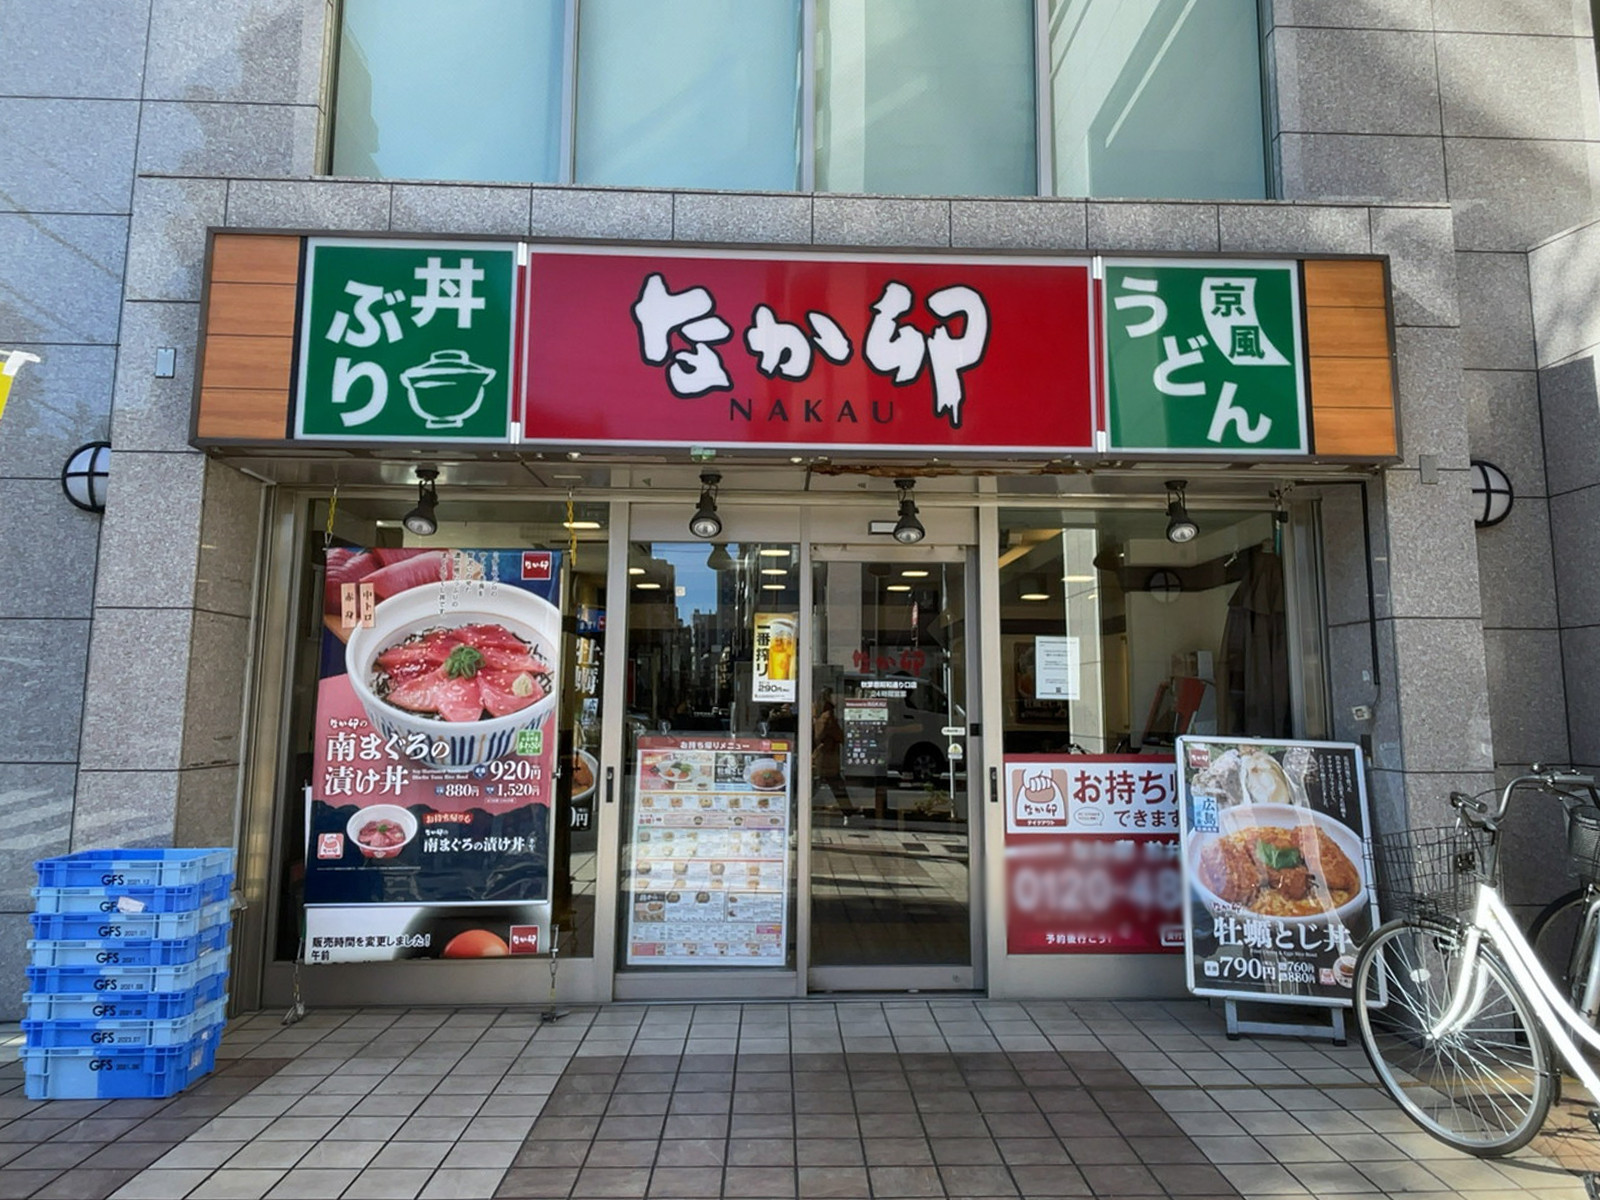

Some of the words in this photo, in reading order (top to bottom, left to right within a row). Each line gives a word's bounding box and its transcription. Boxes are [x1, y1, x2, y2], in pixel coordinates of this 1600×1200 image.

[1209, 281, 1265, 360] 京風
[631, 271, 990, 429] なか卯
[1113, 276, 1272, 444] うどん
[730, 397, 895, 424] NAKAU
[524, 560, 549, 571] なか卯
[344, 591, 354, 620] 赤身
[362, 590, 373, 621] 中トロ
[755, 624, 771, 677] 一番搾り
[852, 648, 926, 676] なか卯
[329, 719, 368, 729] なか卯の
[326, 730, 450, 763] 南まぐろの
[680, 741, 750, 750] お持ち帰りメニュー
[490, 759, 541, 781] 920円
[324, 764, 410, 797] 漬け丼
[445, 783, 480, 797] 880円
[497, 783, 540, 798] 1,520円
[1024, 804, 1058, 817] なか卯
[1202, 797, 1216, 826] 広島
[423, 836, 526, 853] 南まぐろの漬け丼
[101, 874, 124, 886] GFS
[99, 901, 120, 913] GF
[97, 925, 121, 937] GFS
[1213, 916, 1352, 954] 牡蠣とじ丼
[512, 933, 537, 947] なか卯
[96, 952, 119, 964] GFS
[311, 950, 330, 961] 午前
[1219, 956, 1276, 981] 790円
[93, 978, 117, 991] GFS
[92, 1004, 116, 1017] GFS
[90, 1032, 115, 1044] GFS
[89, 1059, 113, 1071] GFS
